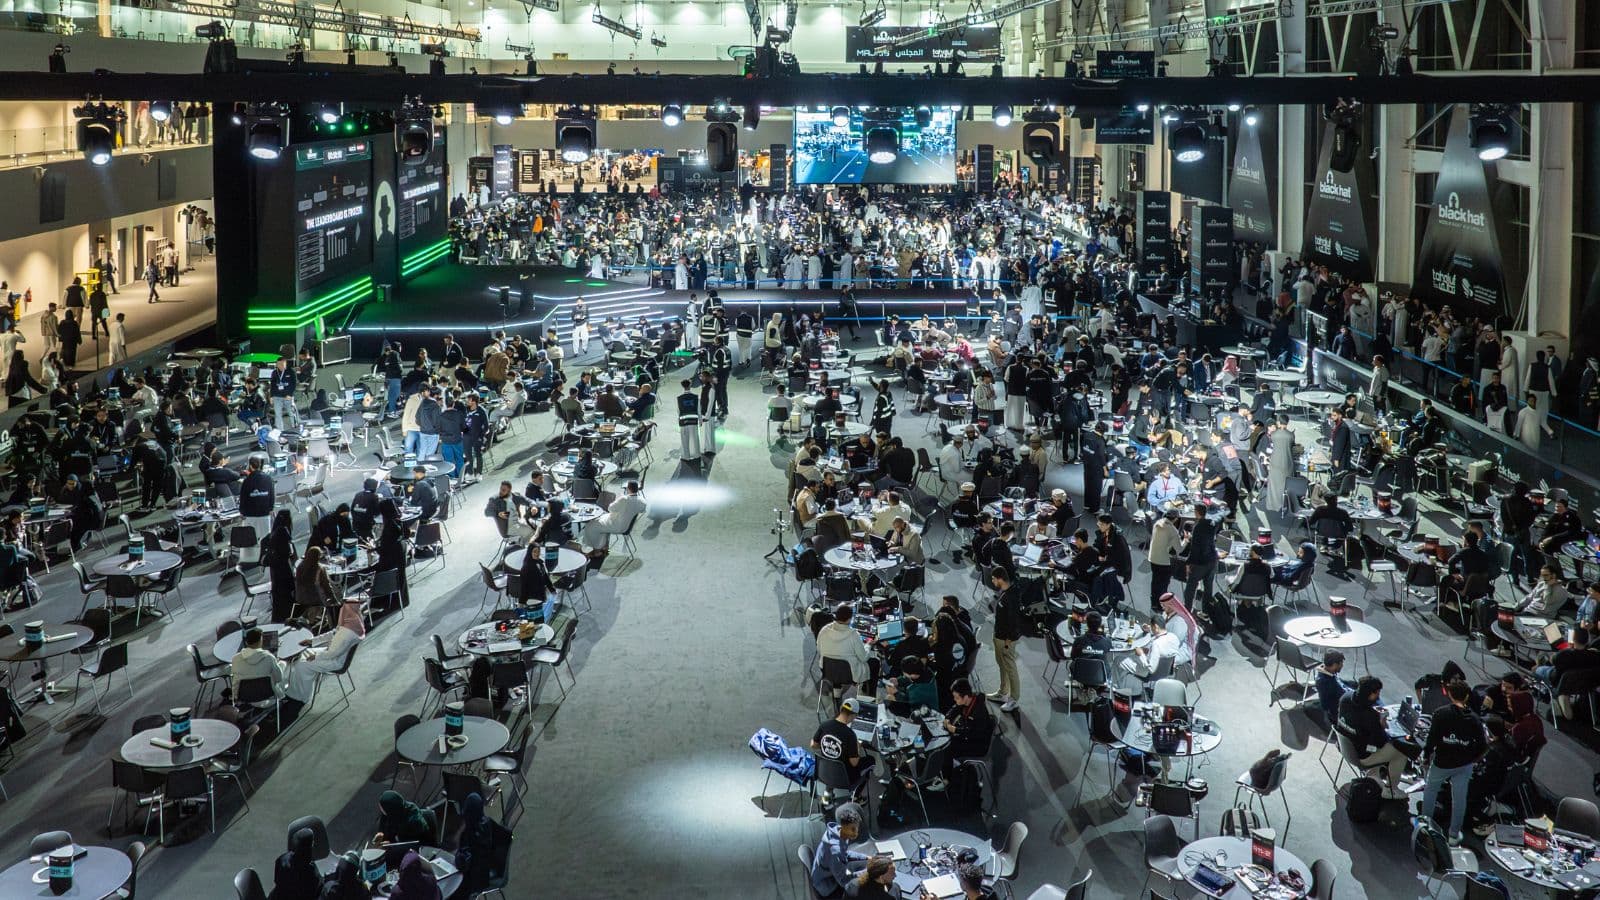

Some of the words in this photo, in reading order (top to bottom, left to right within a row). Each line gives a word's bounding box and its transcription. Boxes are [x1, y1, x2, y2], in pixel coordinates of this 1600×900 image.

[895, 49, 924, 57] المجلس
[1320, 181, 1339, 196] black
[1339, 185, 1352, 198] hat
[1439, 203, 1467, 222] black
[1467, 209, 1485, 226] hat
